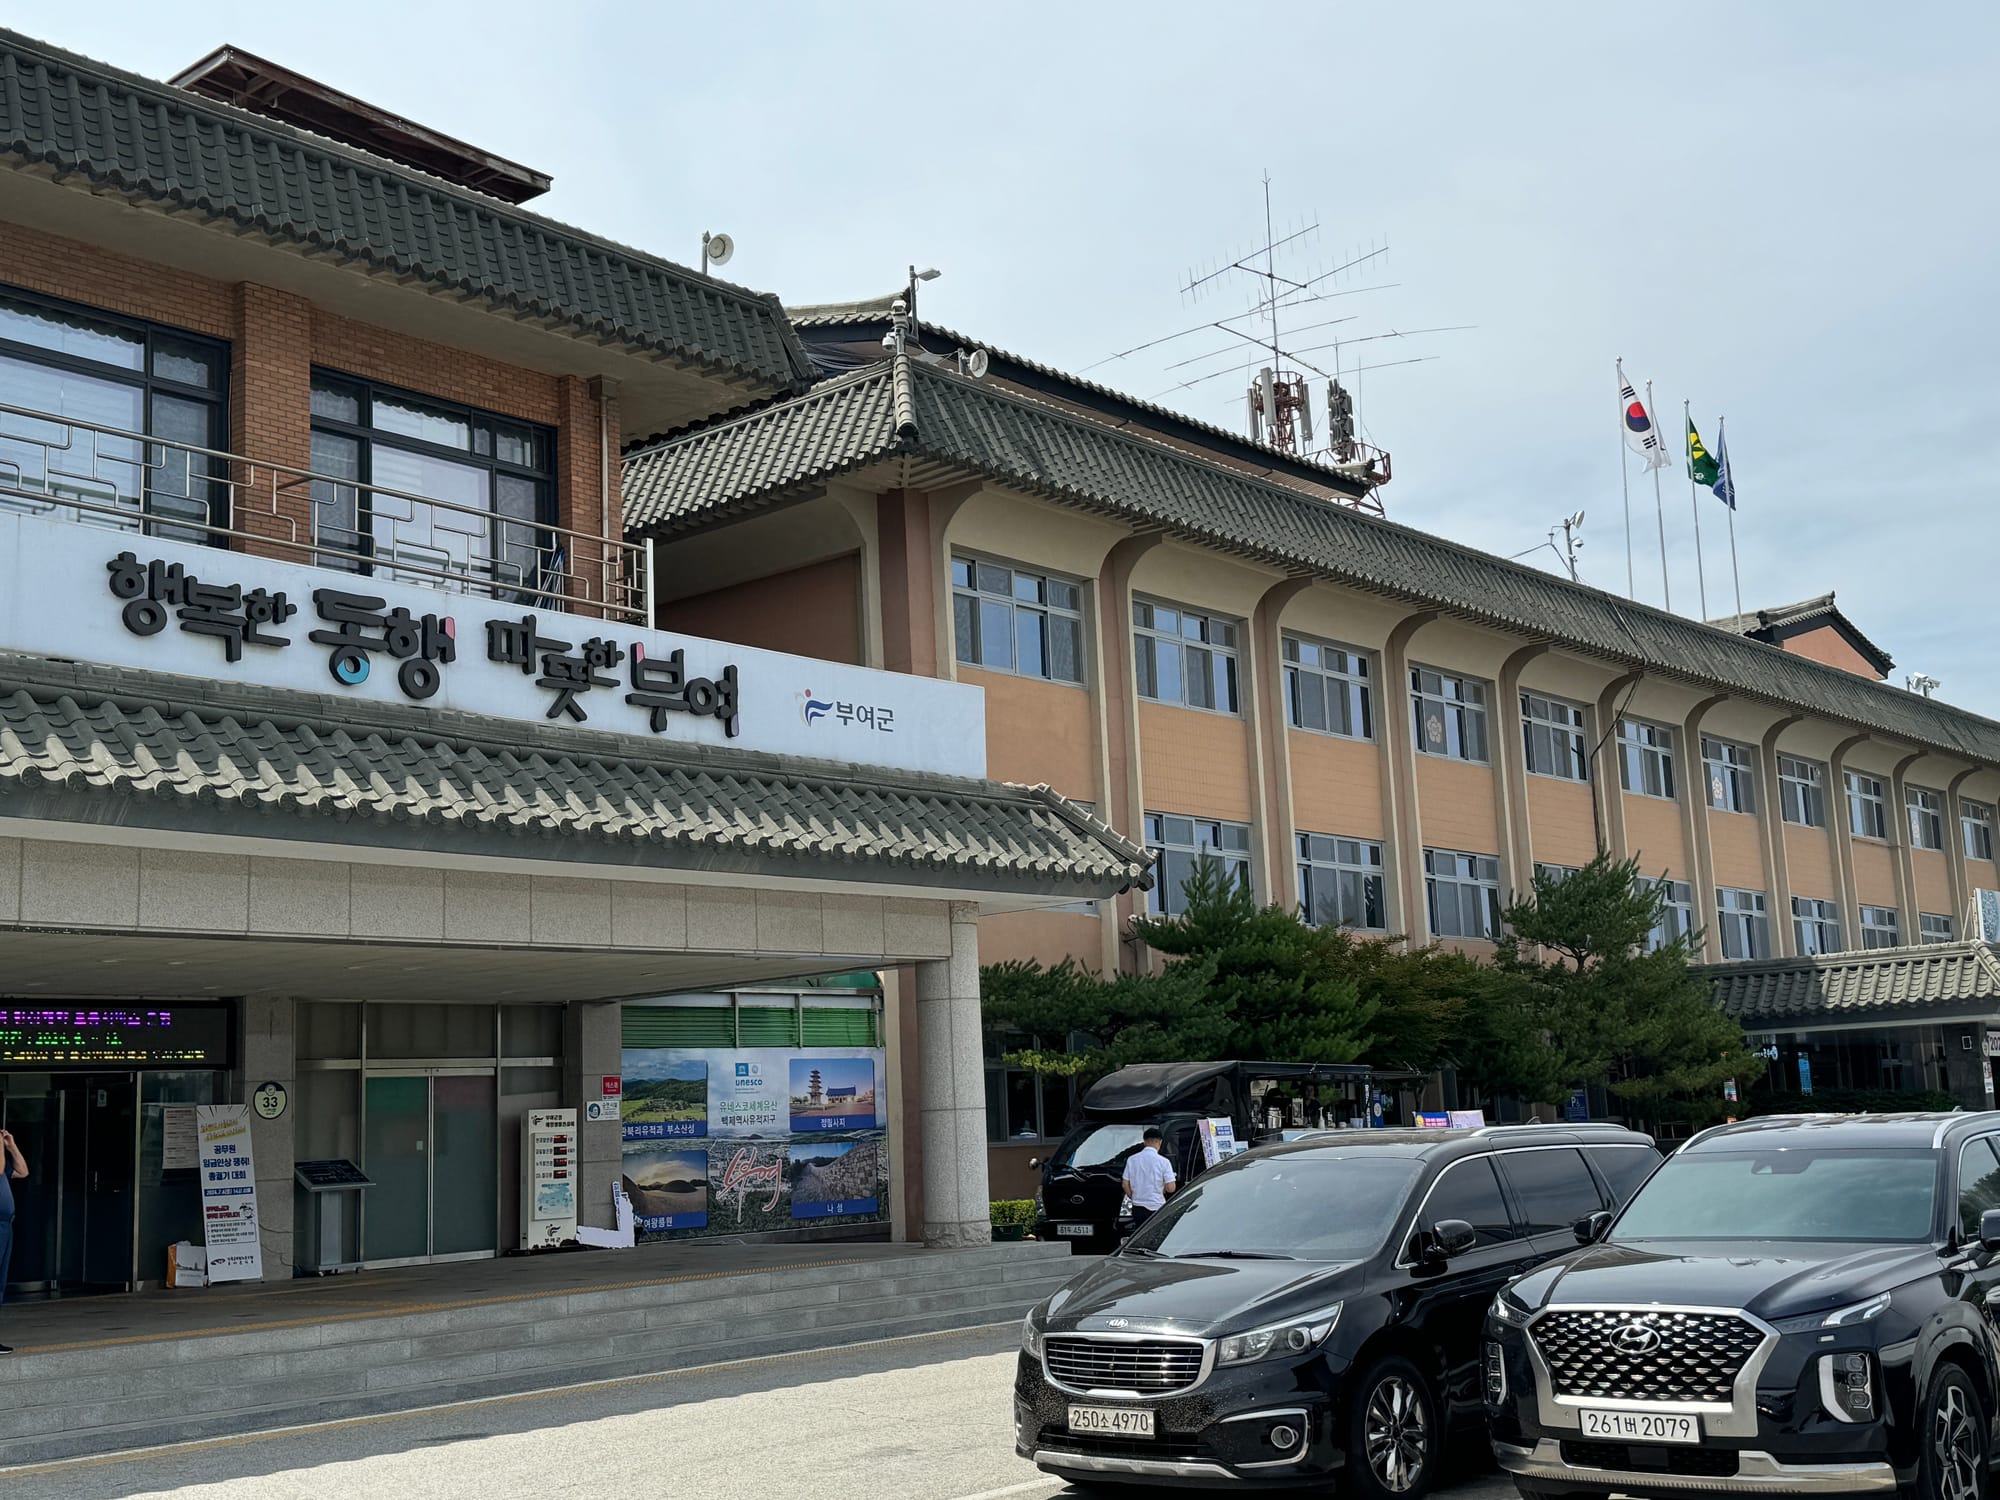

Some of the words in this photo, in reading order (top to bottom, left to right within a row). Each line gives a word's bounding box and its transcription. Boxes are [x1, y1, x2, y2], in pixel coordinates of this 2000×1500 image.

[106, 551, 297, 663] 행복한
[308, 588, 456, 699] 동행
[485, 613, 625, 722] 따뜻한
[625, 641, 740, 739] 부여
[834, 701, 895, 733] 부여군
[735, 1078, 763, 1087] unesco
[262, 1096, 278, 1108] 33
[719, 1099, 778, 1113] 유네스코세계유산
[721, 1114, 776, 1126] 백제역사유적지구
[820, 1117, 846, 1128] 정림사지
[667, 1122, 695, 1135] 부소산성
[213, 1144, 237, 1154] 공무원
[203, 1158, 232, 1168] 임금인상
[232, 1157, 250, 1166] 쟁취!
[208, 1171, 230, 1181] 총궐기
[231, 1170, 247, 1180] 대회
[638, 1215, 673, 1229] 여왕릉원
[1108, 1319, 1126, 1328] KIA
